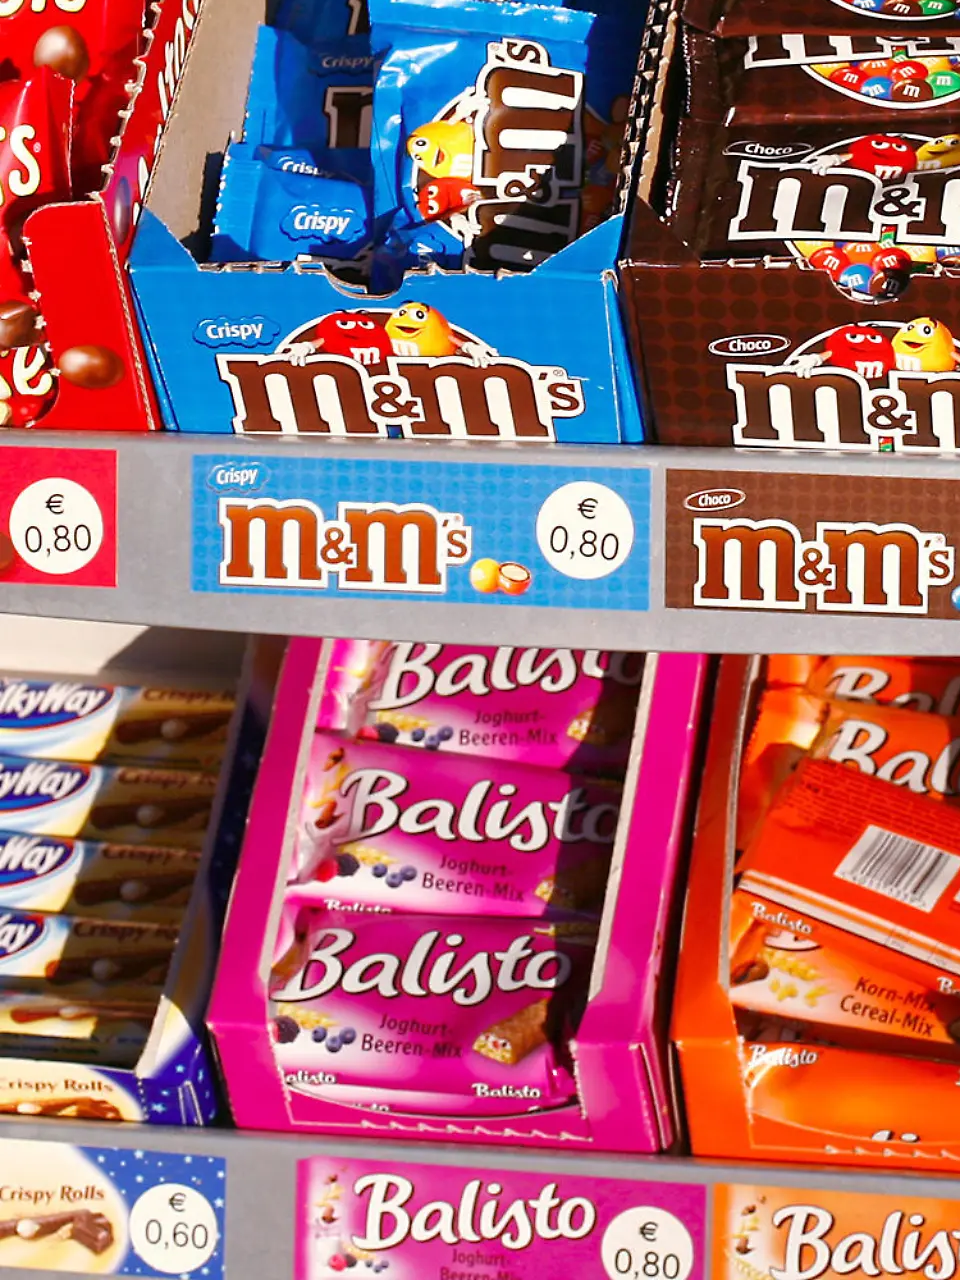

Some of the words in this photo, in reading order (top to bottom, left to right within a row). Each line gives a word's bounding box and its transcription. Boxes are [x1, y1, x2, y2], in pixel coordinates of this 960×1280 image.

[745, 142, 794, 158] Choco
[293, 212, 351, 236] Crispy
[205, 320, 264, 341] Crispy
[728, 337, 772, 352] Choco
[215, 466, 258, 485] Crispy
[45, 493, 65, 515] €
[577, 498, 600, 520] €
[698, 492, 732, 507] Choco
[24, 523, 93, 557] 0,80
[549, 526, 620, 562] 0,80
[0, 682, 106, 719] lkyWay
[458, 730, 558, 746] Beeren-Mix
[333, 768, 618, 852] Balisto
[422, 872, 525, 902] Beeren-Mix
[751, 902, 813, 936] Balisto
[270, 927, 573, 1006] Balisto
[855, 976, 937, 1014] Korn-Mix
[839, 995, 936, 1038] Cereal-Mix
[361, 1034, 464, 1059] Beeren-Mix
[63, 1078, 115, 1093] Rolls
[284, 1070, 337, 1085] alisto
[471, 1083, 542, 1099] Balisto
[60, 1184, 106, 1202] Rolls
[168, 1192, 188, 1212] €
[352, 1172, 597, 1251] Balisto
[145, 1219, 209, 1250] 0,60
[638, 1221, 658, 1241] €
[615, 1248, 681, 1280] 0,80
